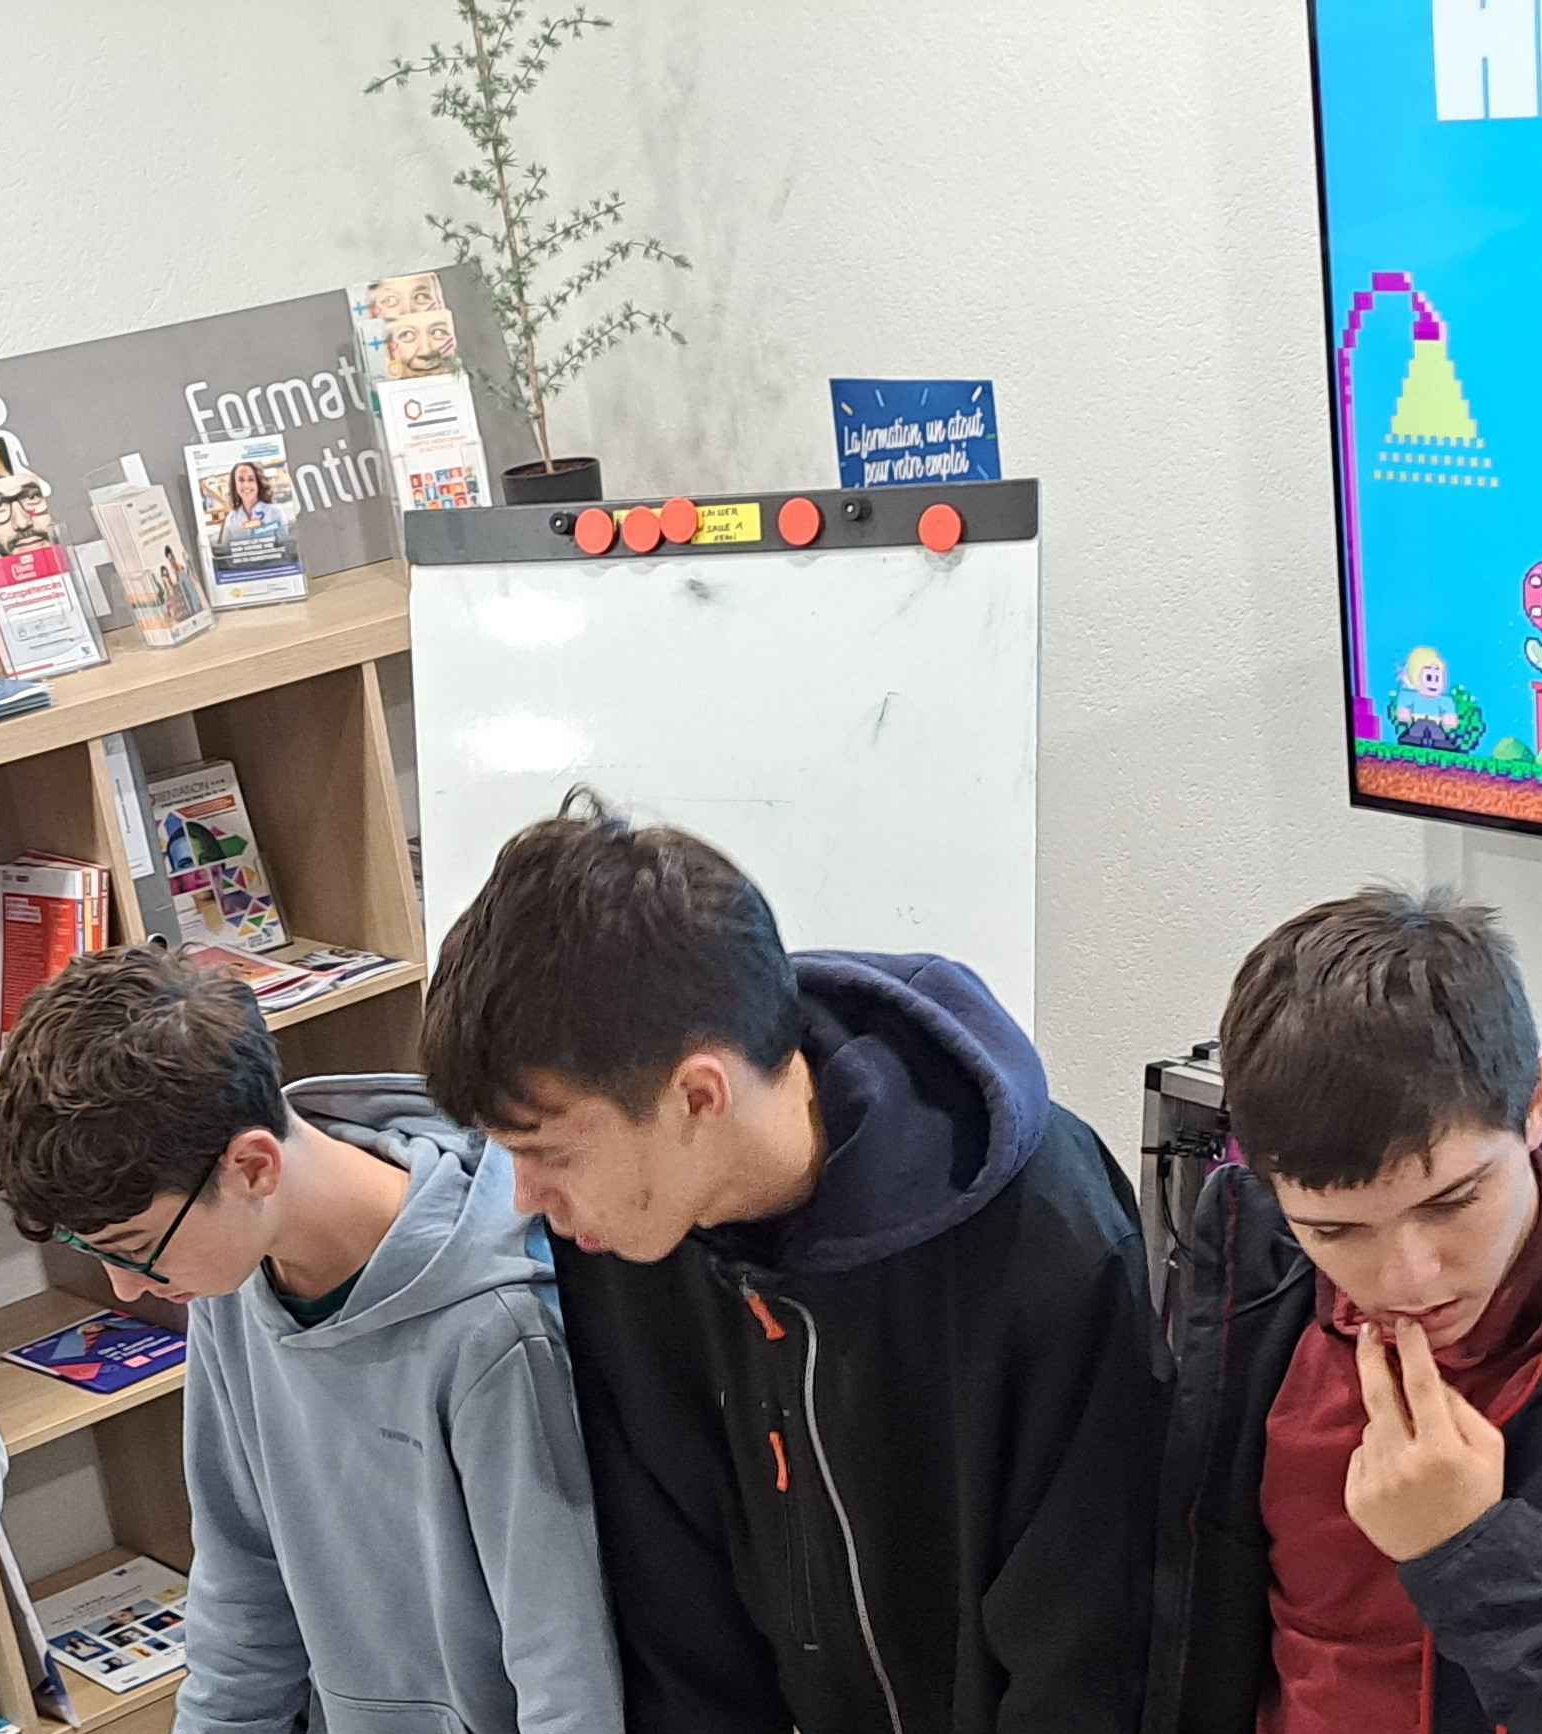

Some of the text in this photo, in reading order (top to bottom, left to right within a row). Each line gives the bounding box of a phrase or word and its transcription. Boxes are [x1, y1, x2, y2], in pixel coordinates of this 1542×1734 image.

[185, 355, 367, 443] Format
[844, 407, 984, 460] La formation, un atout
[864, 442, 970, 488] pour votre emploi
